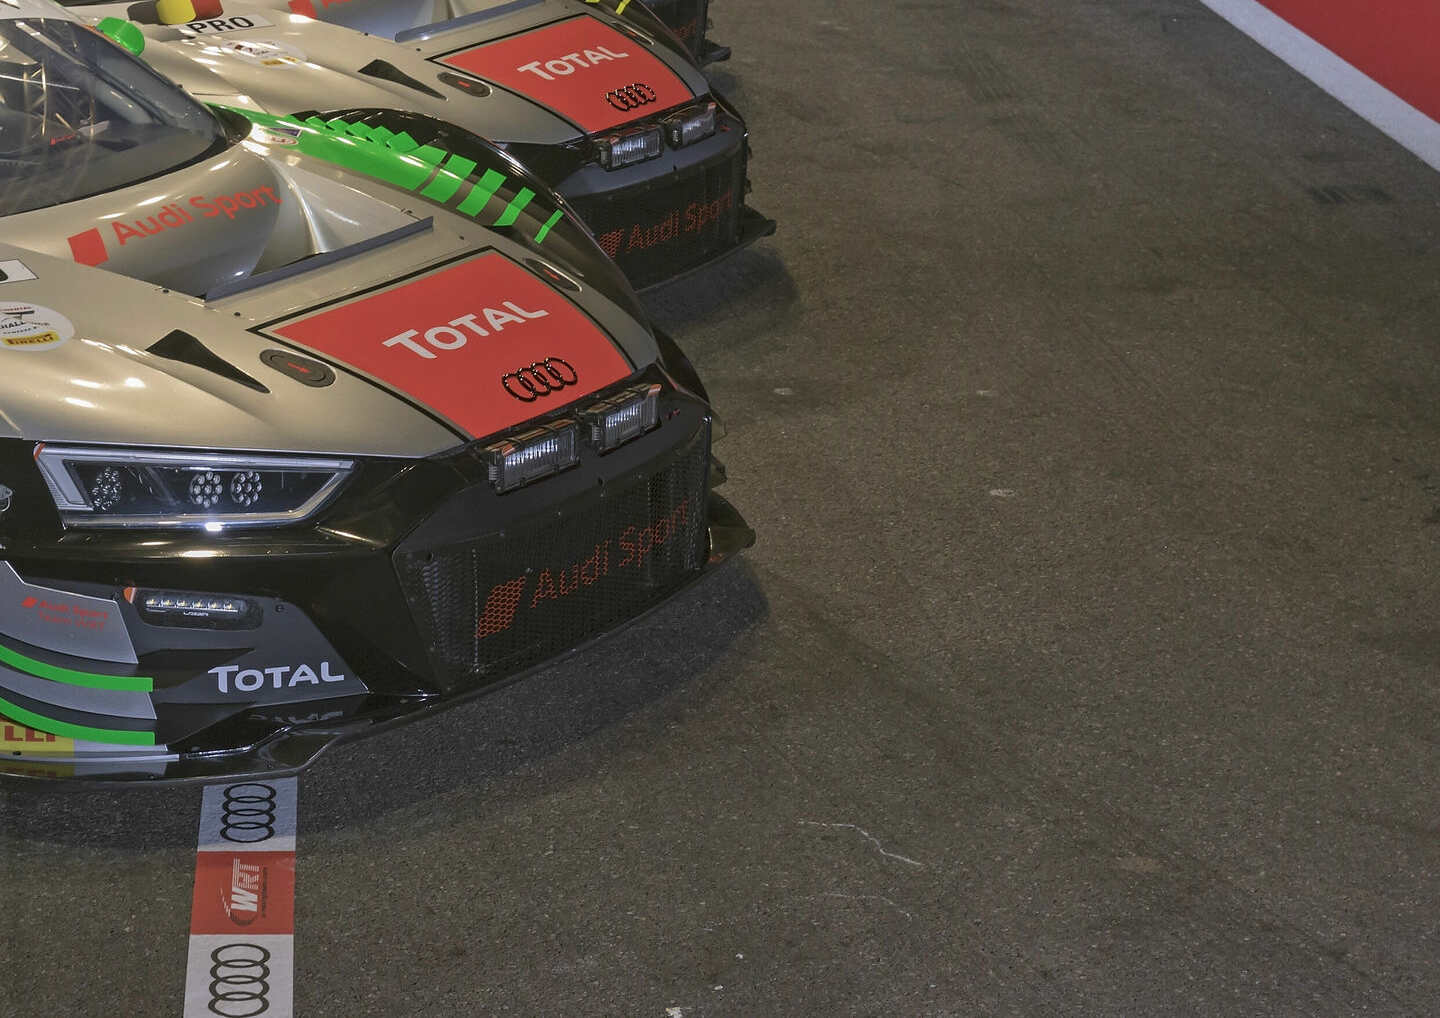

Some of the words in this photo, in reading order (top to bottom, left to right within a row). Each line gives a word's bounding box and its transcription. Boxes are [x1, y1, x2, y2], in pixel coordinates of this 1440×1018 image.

[186, 16, 255, 34] PRO
[516, 45, 629, 81] TOTAL
[112, 205, 194, 246] Audi
[188, 184, 284, 219] Sport
[625, 208, 680, 255] Audi
[684, 191, 735, 234] Sport
[6, 333, 54, 345] PIRELLI
[382, 301, 549, 359] TOTAL
[529, 540, 611, 610] Audi
[618, 500, 689, 568] Sport
[38, 600, 69, 613] Audi
[72, 606, 109, 621] Sport
[38, 611, 73, 626] Team
[77, 619, 106, 631] WRT
[208, 660, 345, 694] TOTAL
[231, 858, 260, 913] WRT
